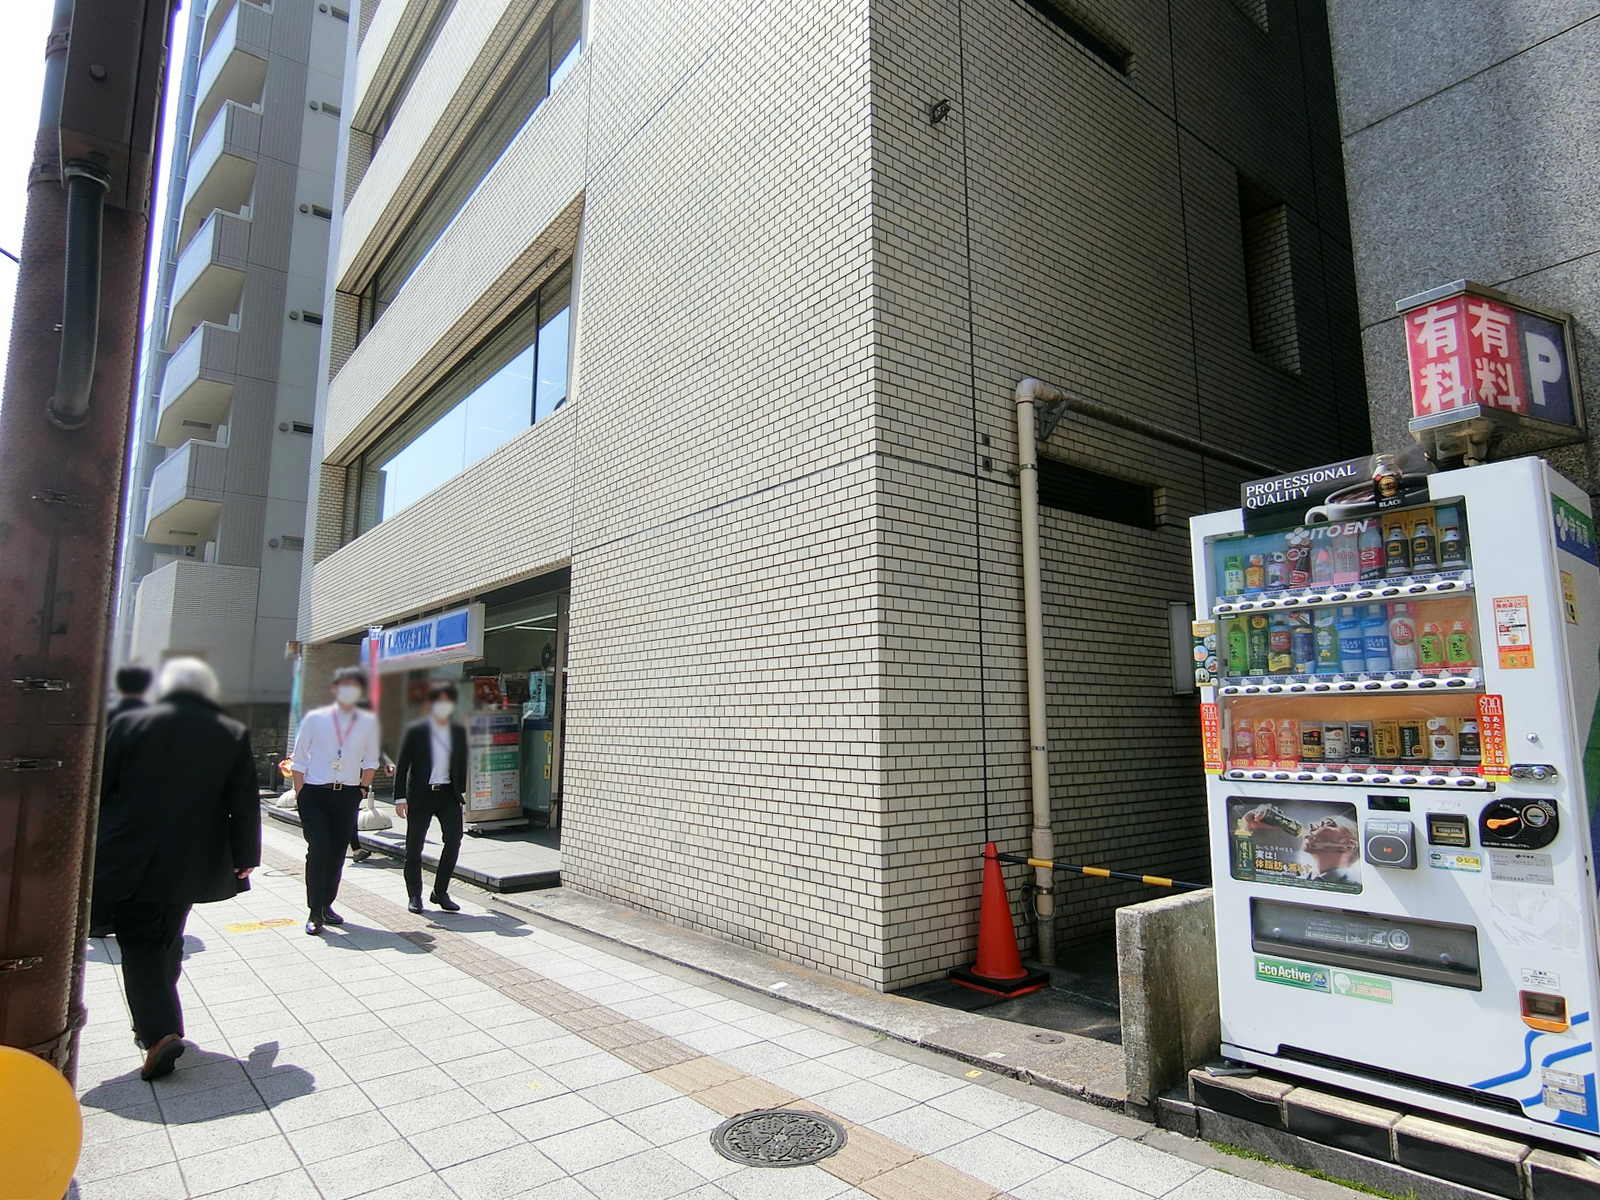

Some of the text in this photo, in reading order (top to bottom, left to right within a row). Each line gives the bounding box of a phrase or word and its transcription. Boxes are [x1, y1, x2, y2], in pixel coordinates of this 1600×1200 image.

[1414, 303, 1466, 414] 有料
[1468, 302, 1522, 413] 有料
[1524, 331, 1562, 406] P
[1246, 464, 1357, 498] PROFESSIONAL
[1246, 485, 1310, 509] QUALITY
[1309, 519, 1369, 541] ITO EN
[1395, 625, 1409, 637] 桃
[1203, 704, 1218, 720] 温
[1480, 696, 1502, 716] 温
[1482, 716, 1495, 764] 取り揃えました
[1492, 716, 1504, 764] あたたかい飲料
